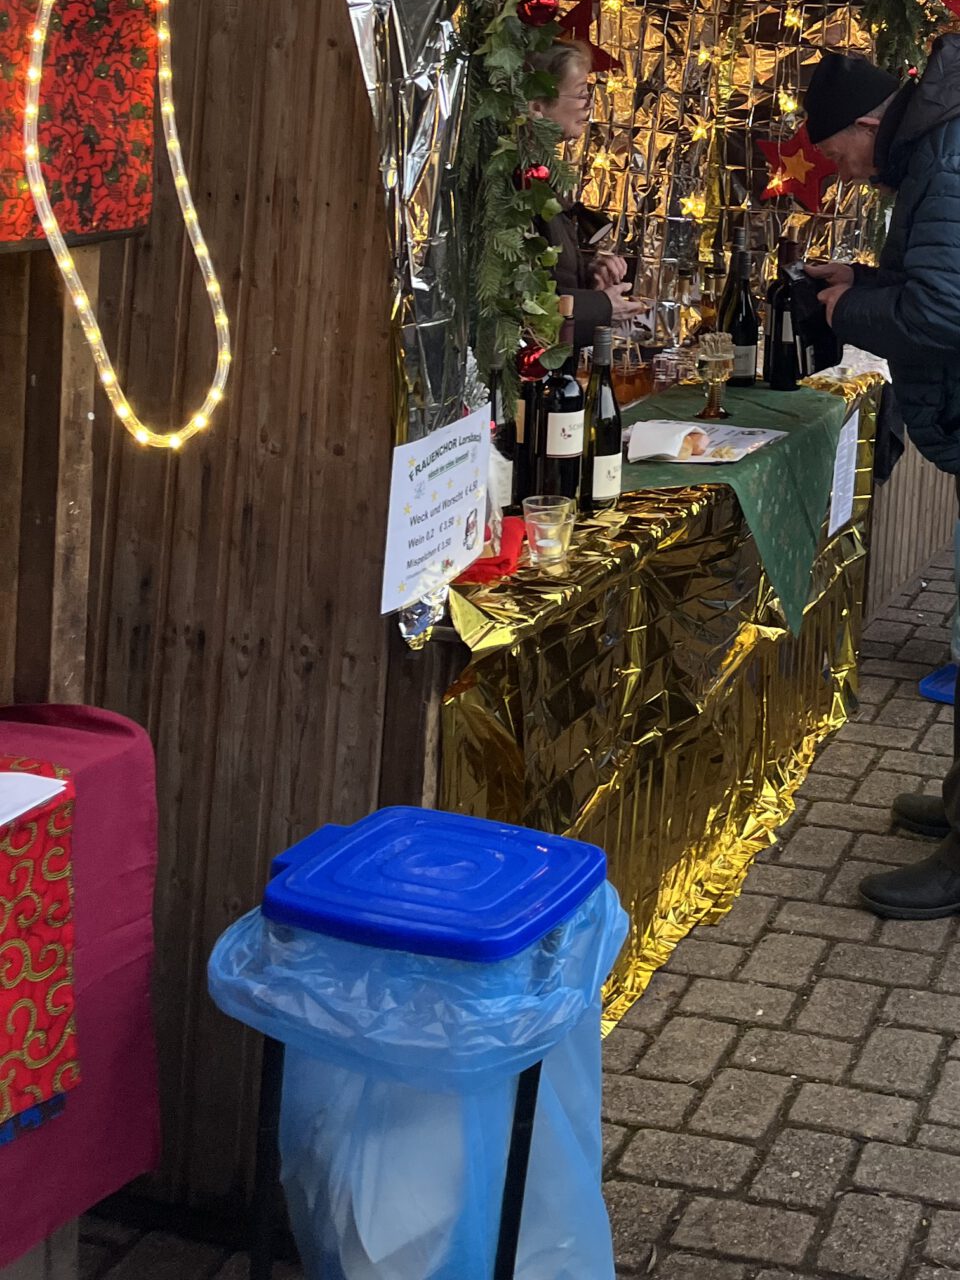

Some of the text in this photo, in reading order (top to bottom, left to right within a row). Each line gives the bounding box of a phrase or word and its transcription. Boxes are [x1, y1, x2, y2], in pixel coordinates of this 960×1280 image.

[408, 437, 458, 482] FRAUENCHOR
[409, 511, 429, 527] Weck
[408, 533, 425, 550] Wein
